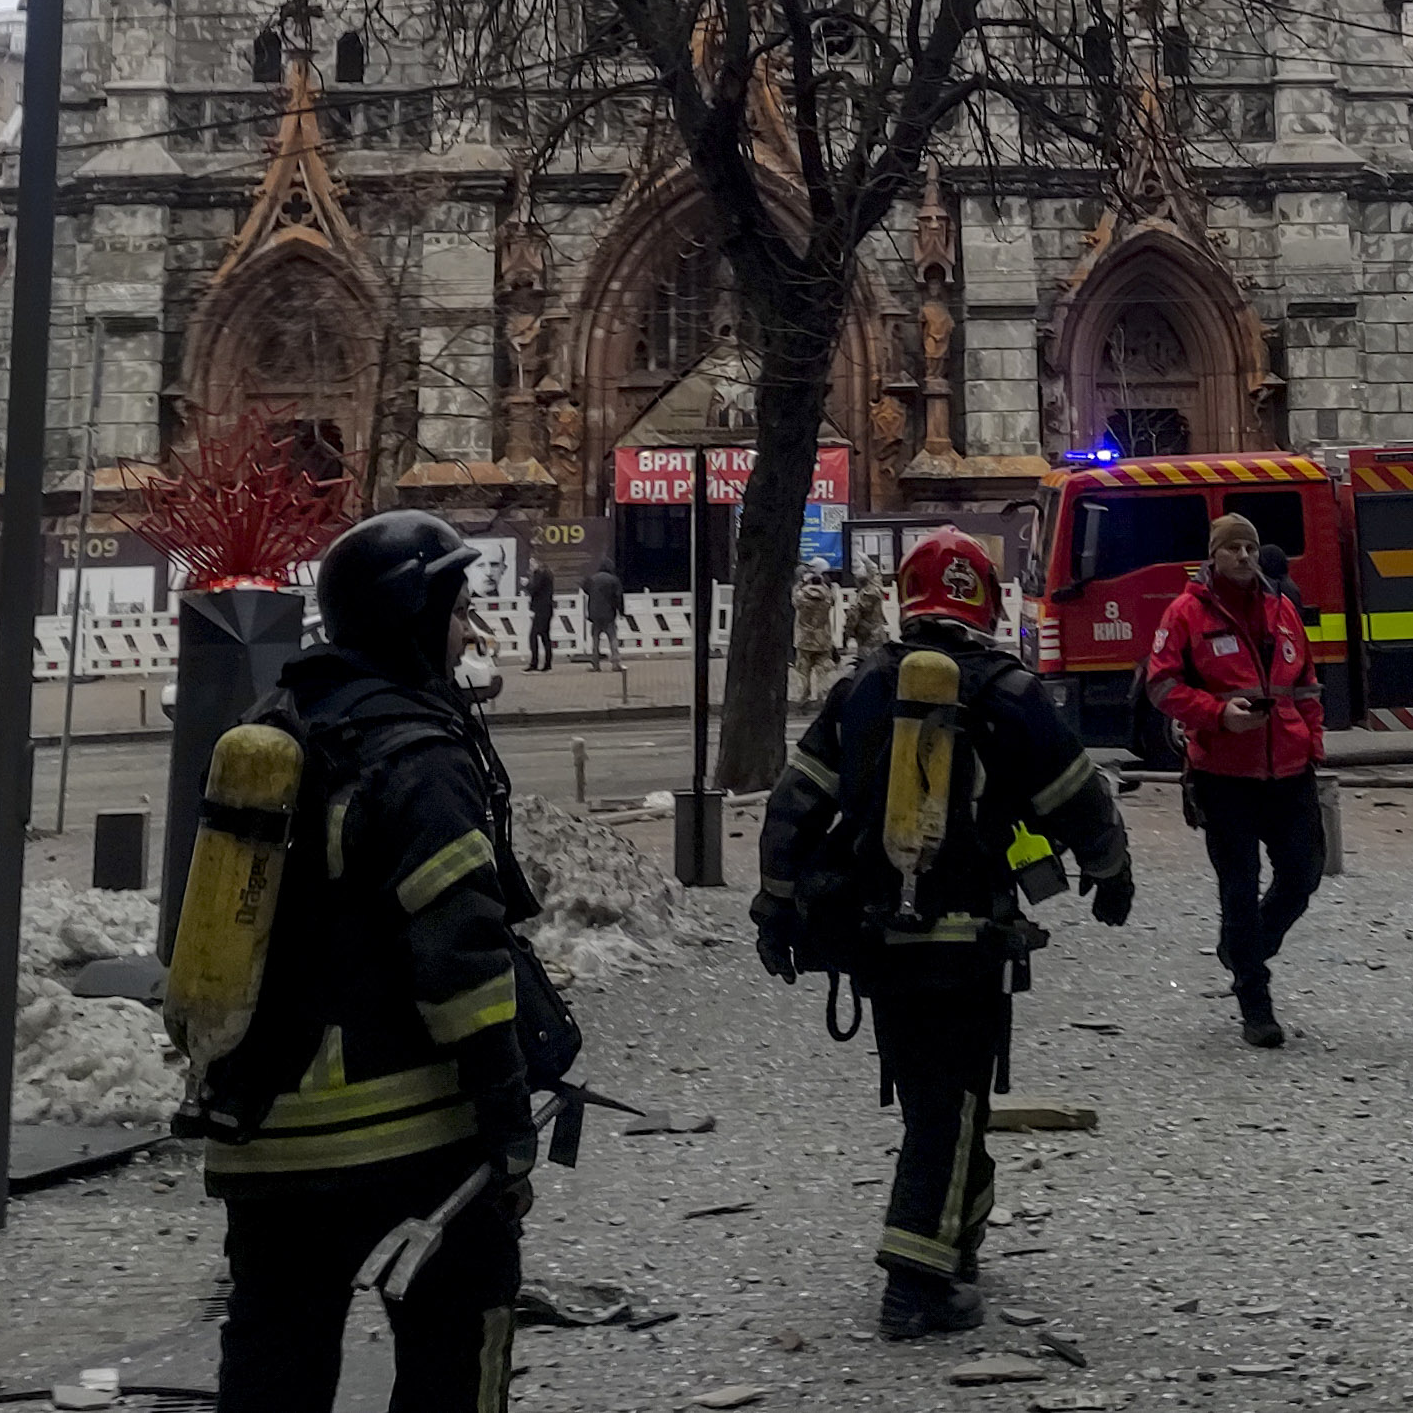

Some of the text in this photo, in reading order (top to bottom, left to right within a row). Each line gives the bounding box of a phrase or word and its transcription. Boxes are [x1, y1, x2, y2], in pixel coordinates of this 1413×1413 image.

[638, 448, 727, 472] ВРЯТЙ
[630, 479, 669, 503] ВІД
[530, 524, 586, 545] 2019
[1104, 600, 1120, 619] 8
[1093, 620, 1133, 641] КИЇВ
